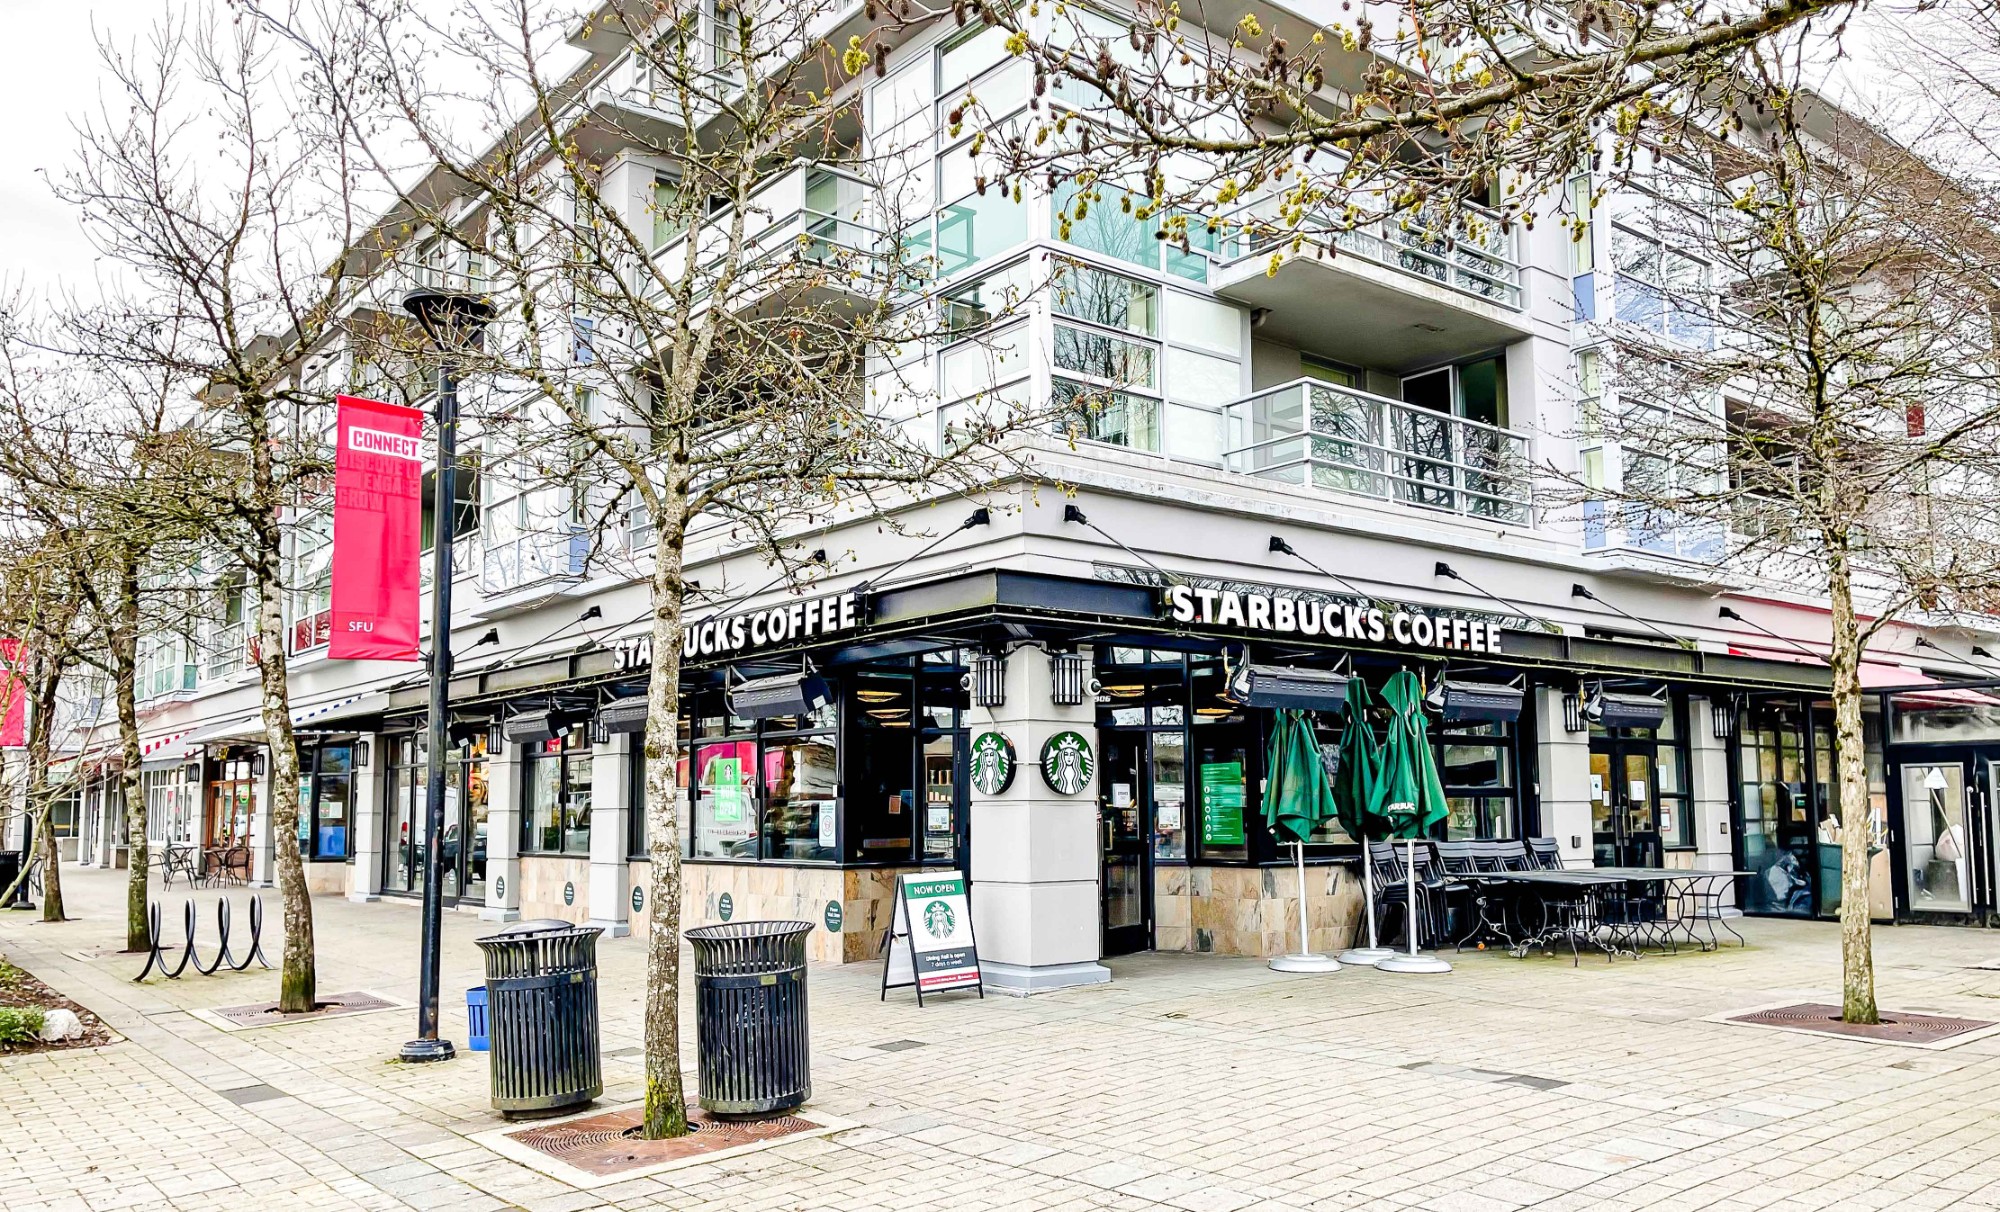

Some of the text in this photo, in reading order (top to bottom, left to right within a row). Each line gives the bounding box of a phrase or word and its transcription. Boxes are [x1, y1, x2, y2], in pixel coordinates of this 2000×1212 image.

[353, 431, 418, 457] CONNECT
[348, 621, 373, 632] SFU
[614, 593, 857, 669] STAUCKS COFFEE
[1172, 584, 1502, 653] STARBUCKS COFFEE
[913, 883, 956, 895] NOW OPEN
